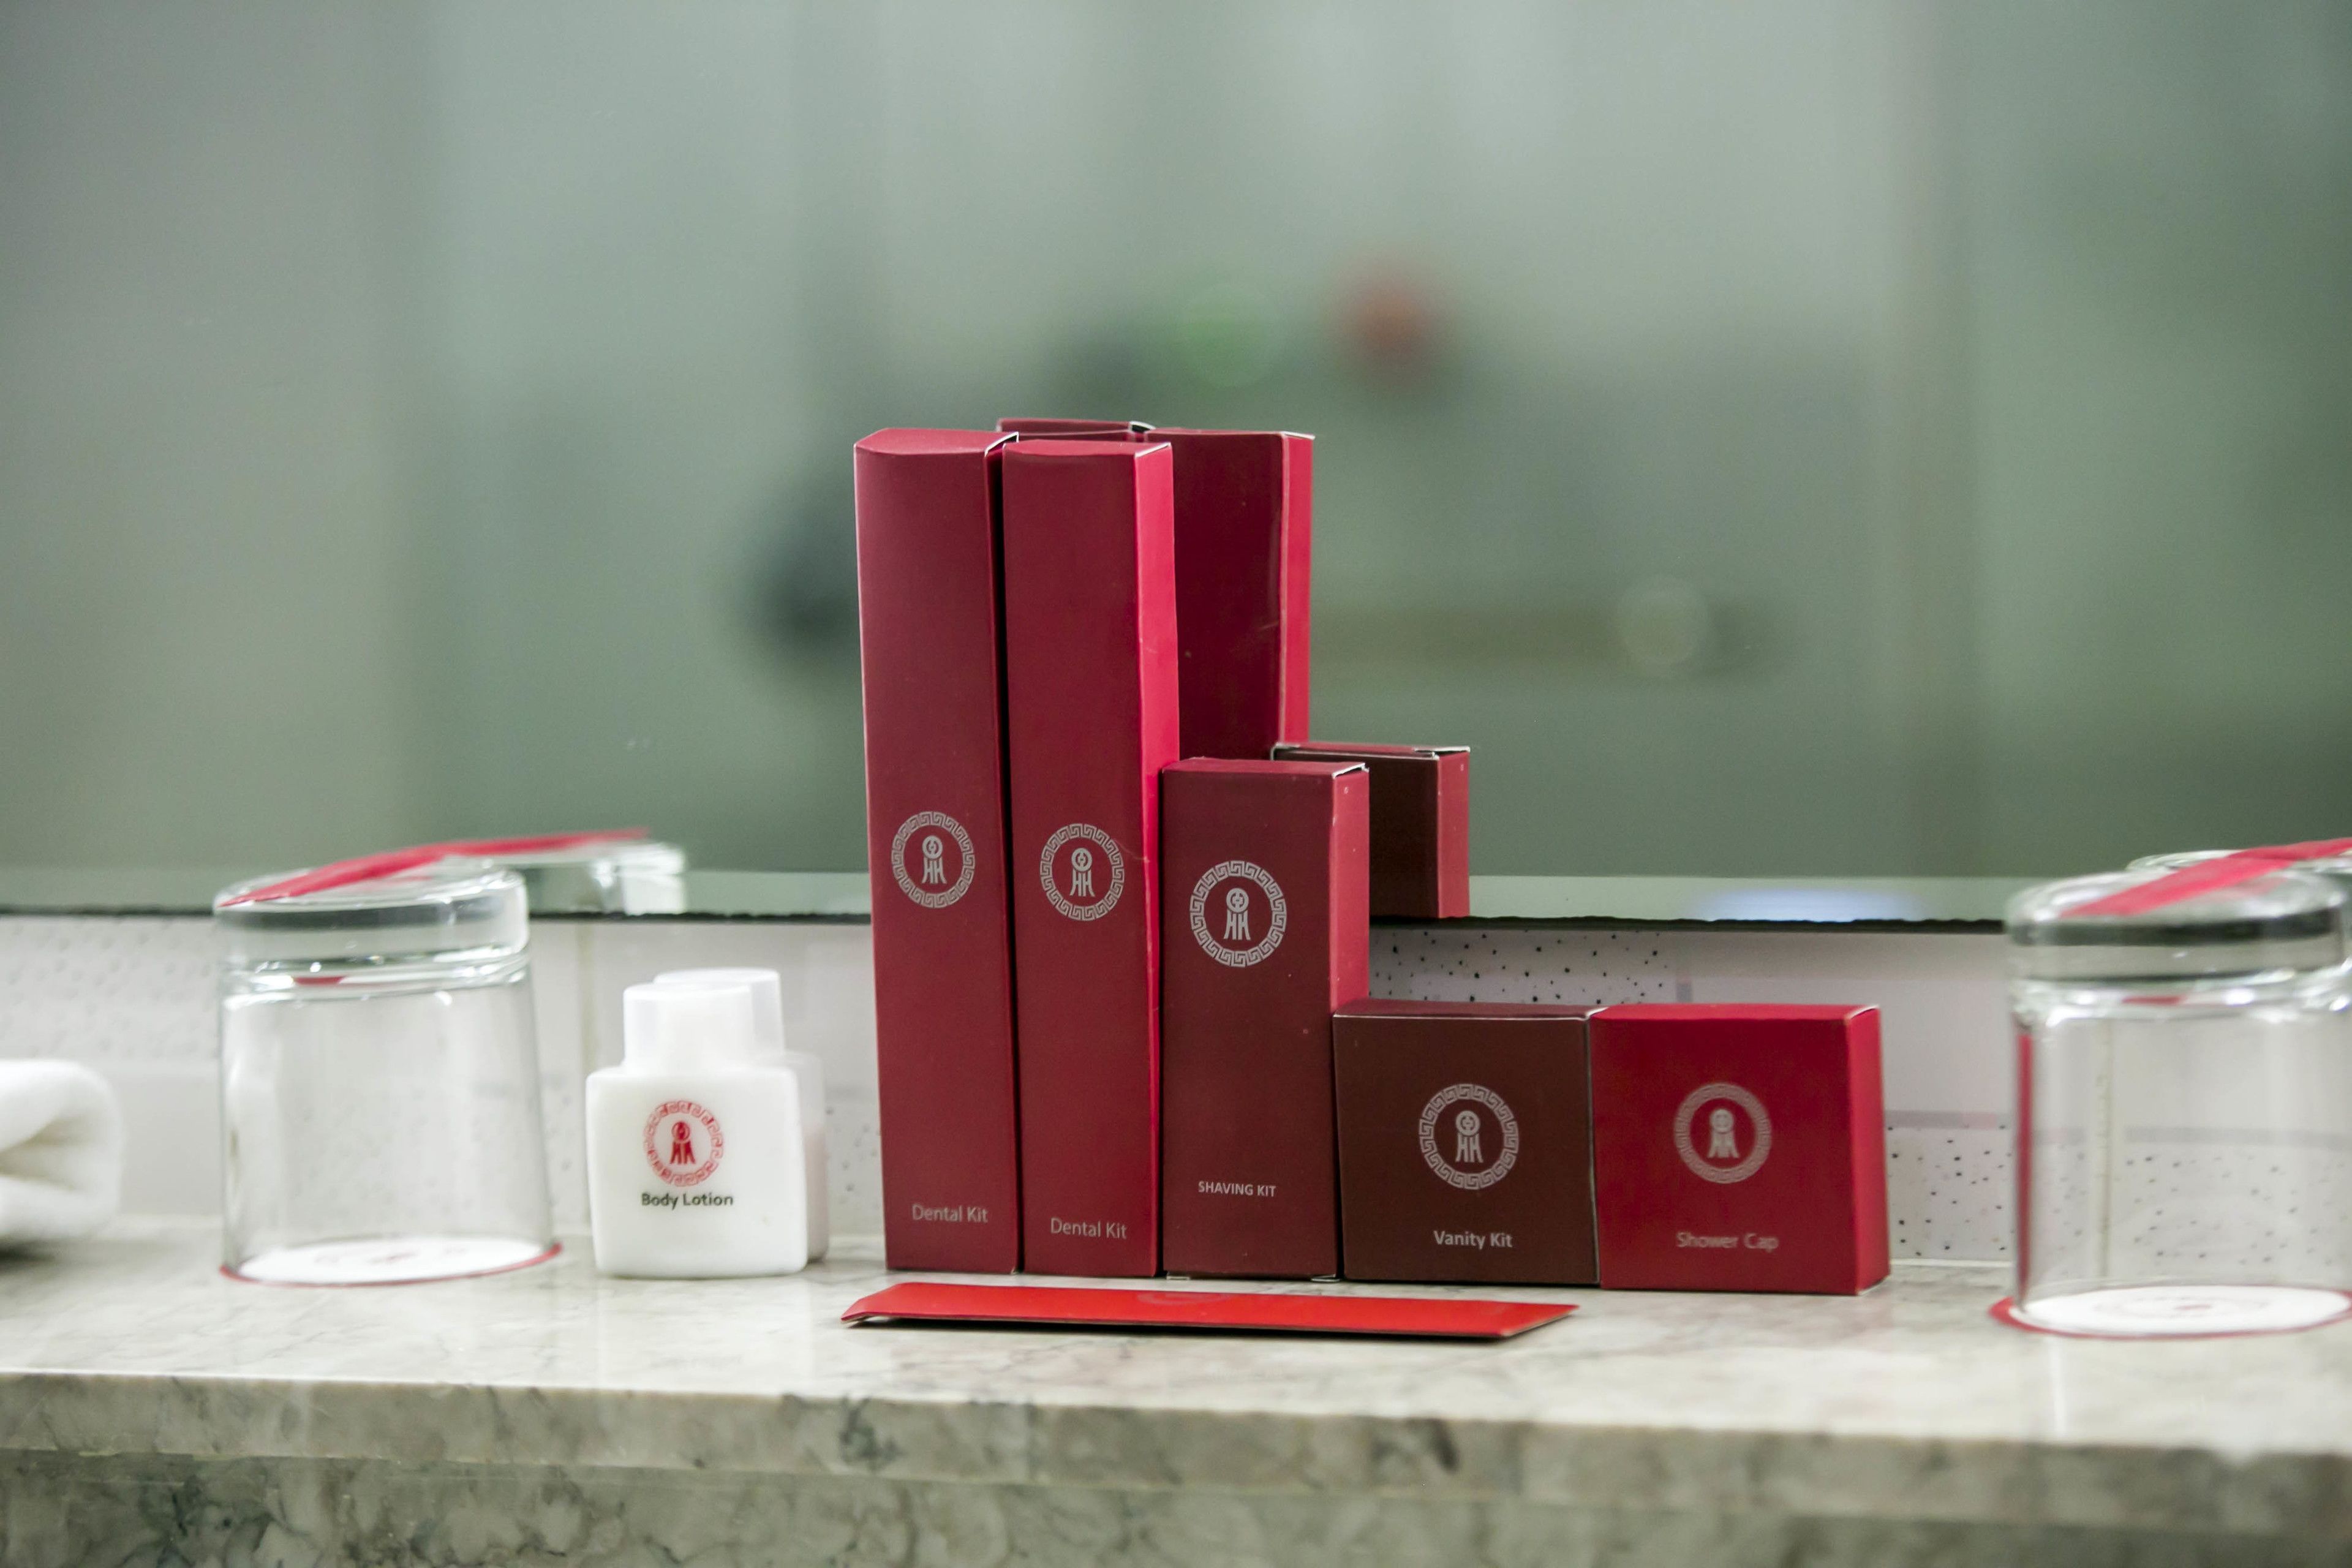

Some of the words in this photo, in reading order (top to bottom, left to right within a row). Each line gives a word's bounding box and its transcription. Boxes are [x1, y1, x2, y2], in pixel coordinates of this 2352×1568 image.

[1198, 1180, 1254, 1197] SHAVING
[1256, 1184, 1278, 1198] KIT
[641, 1192, 679, 1210] Body
[682, 1192, 734, 1207] Lotion
[912, 1203, 963, 1223] Dental
[967, 1206, 989, 1224] Kit
[1050, 1216, 1101, 1237] Dental
[1106, 1222, 1127, 1239] Kit
[1433, 1230, 1486, 1251] Vanity
[1489, 1231, 1513, 1248] Kit
[1675, 1231, 1740, 1250] Shower
[1743, 1233, 1779, 1254] Cap
